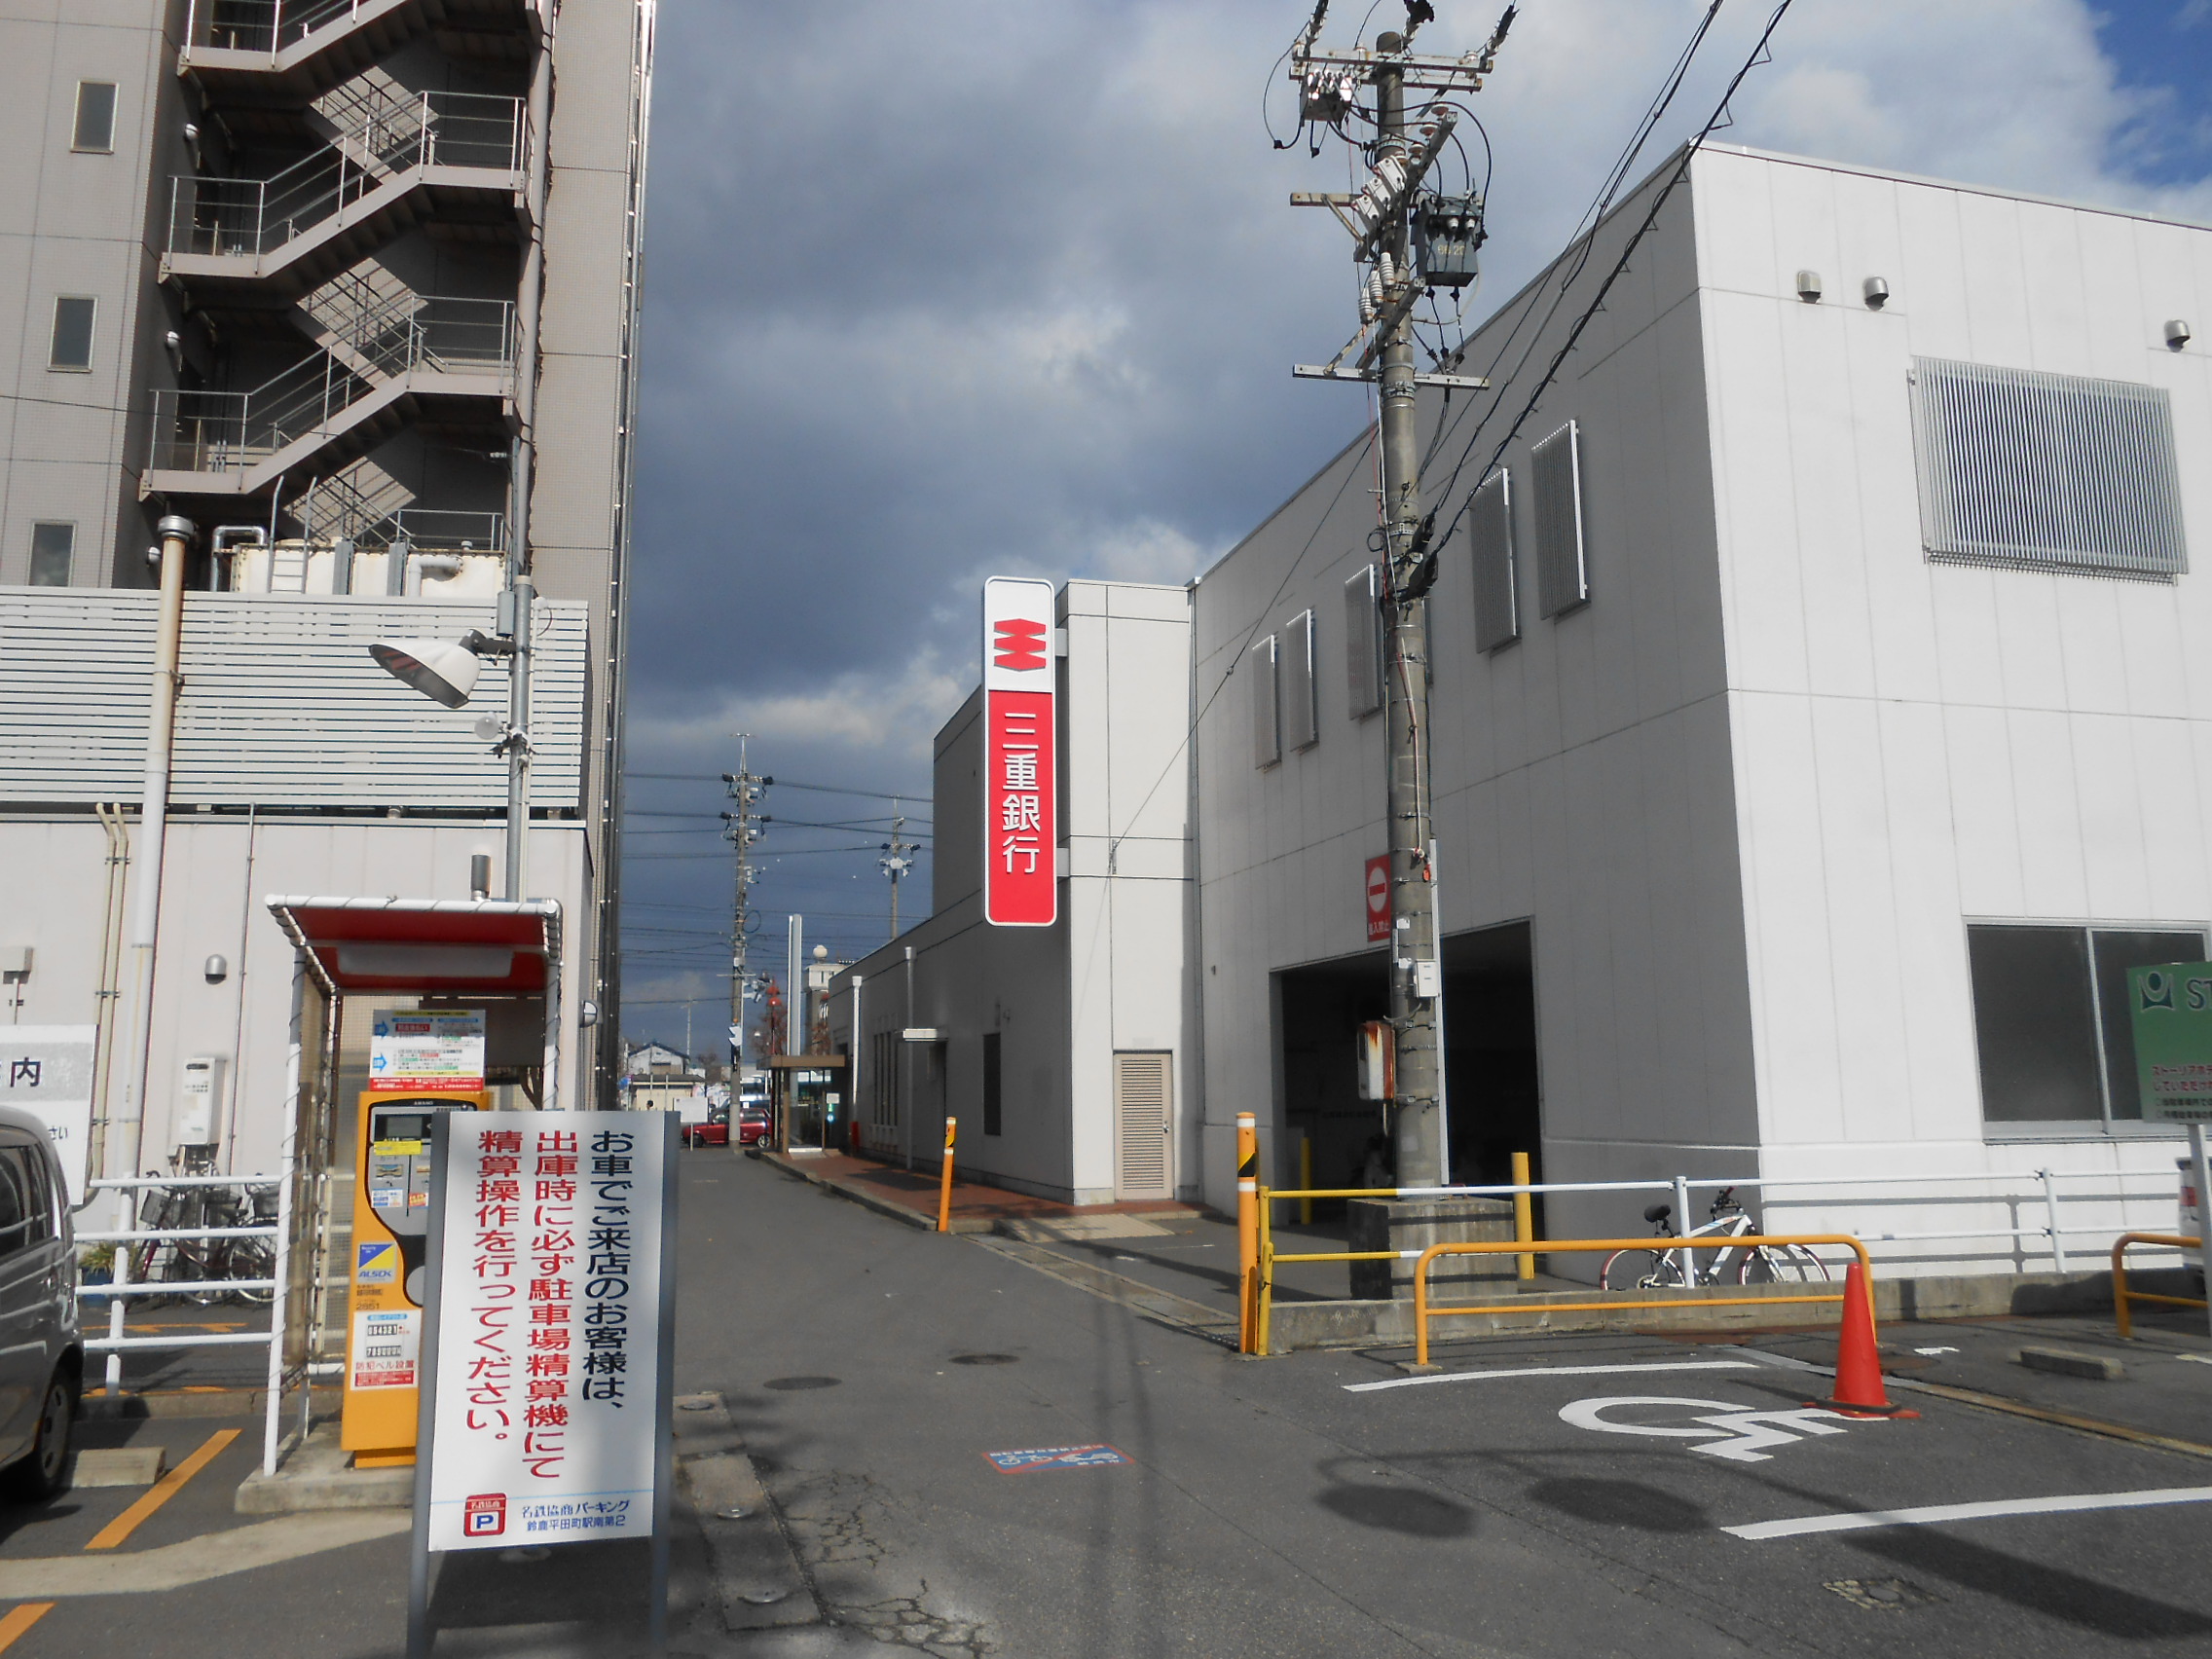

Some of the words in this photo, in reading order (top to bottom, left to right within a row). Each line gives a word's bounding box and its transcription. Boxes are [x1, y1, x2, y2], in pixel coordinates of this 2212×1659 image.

[1002, 712, 1041, 874] 三重銀行
[0, 1056, 42, 1088] 内
[358, 1270, 391, 1278] ALSOK
[466, 1130, 523, 1440] 精算操作を行ってください。
[582, 1129, 635, 1409] お車でご来店のお客様は、
[522, 1130, 577, 1479] 出庫時に必ず駐車場精算機にて
[355, 1359, 415, 1371] 防犯ベル設置
[476, 1514, 494, 1530] P
[527, 1515, 626, 1531] 鈴鹿平田町駅南第2
